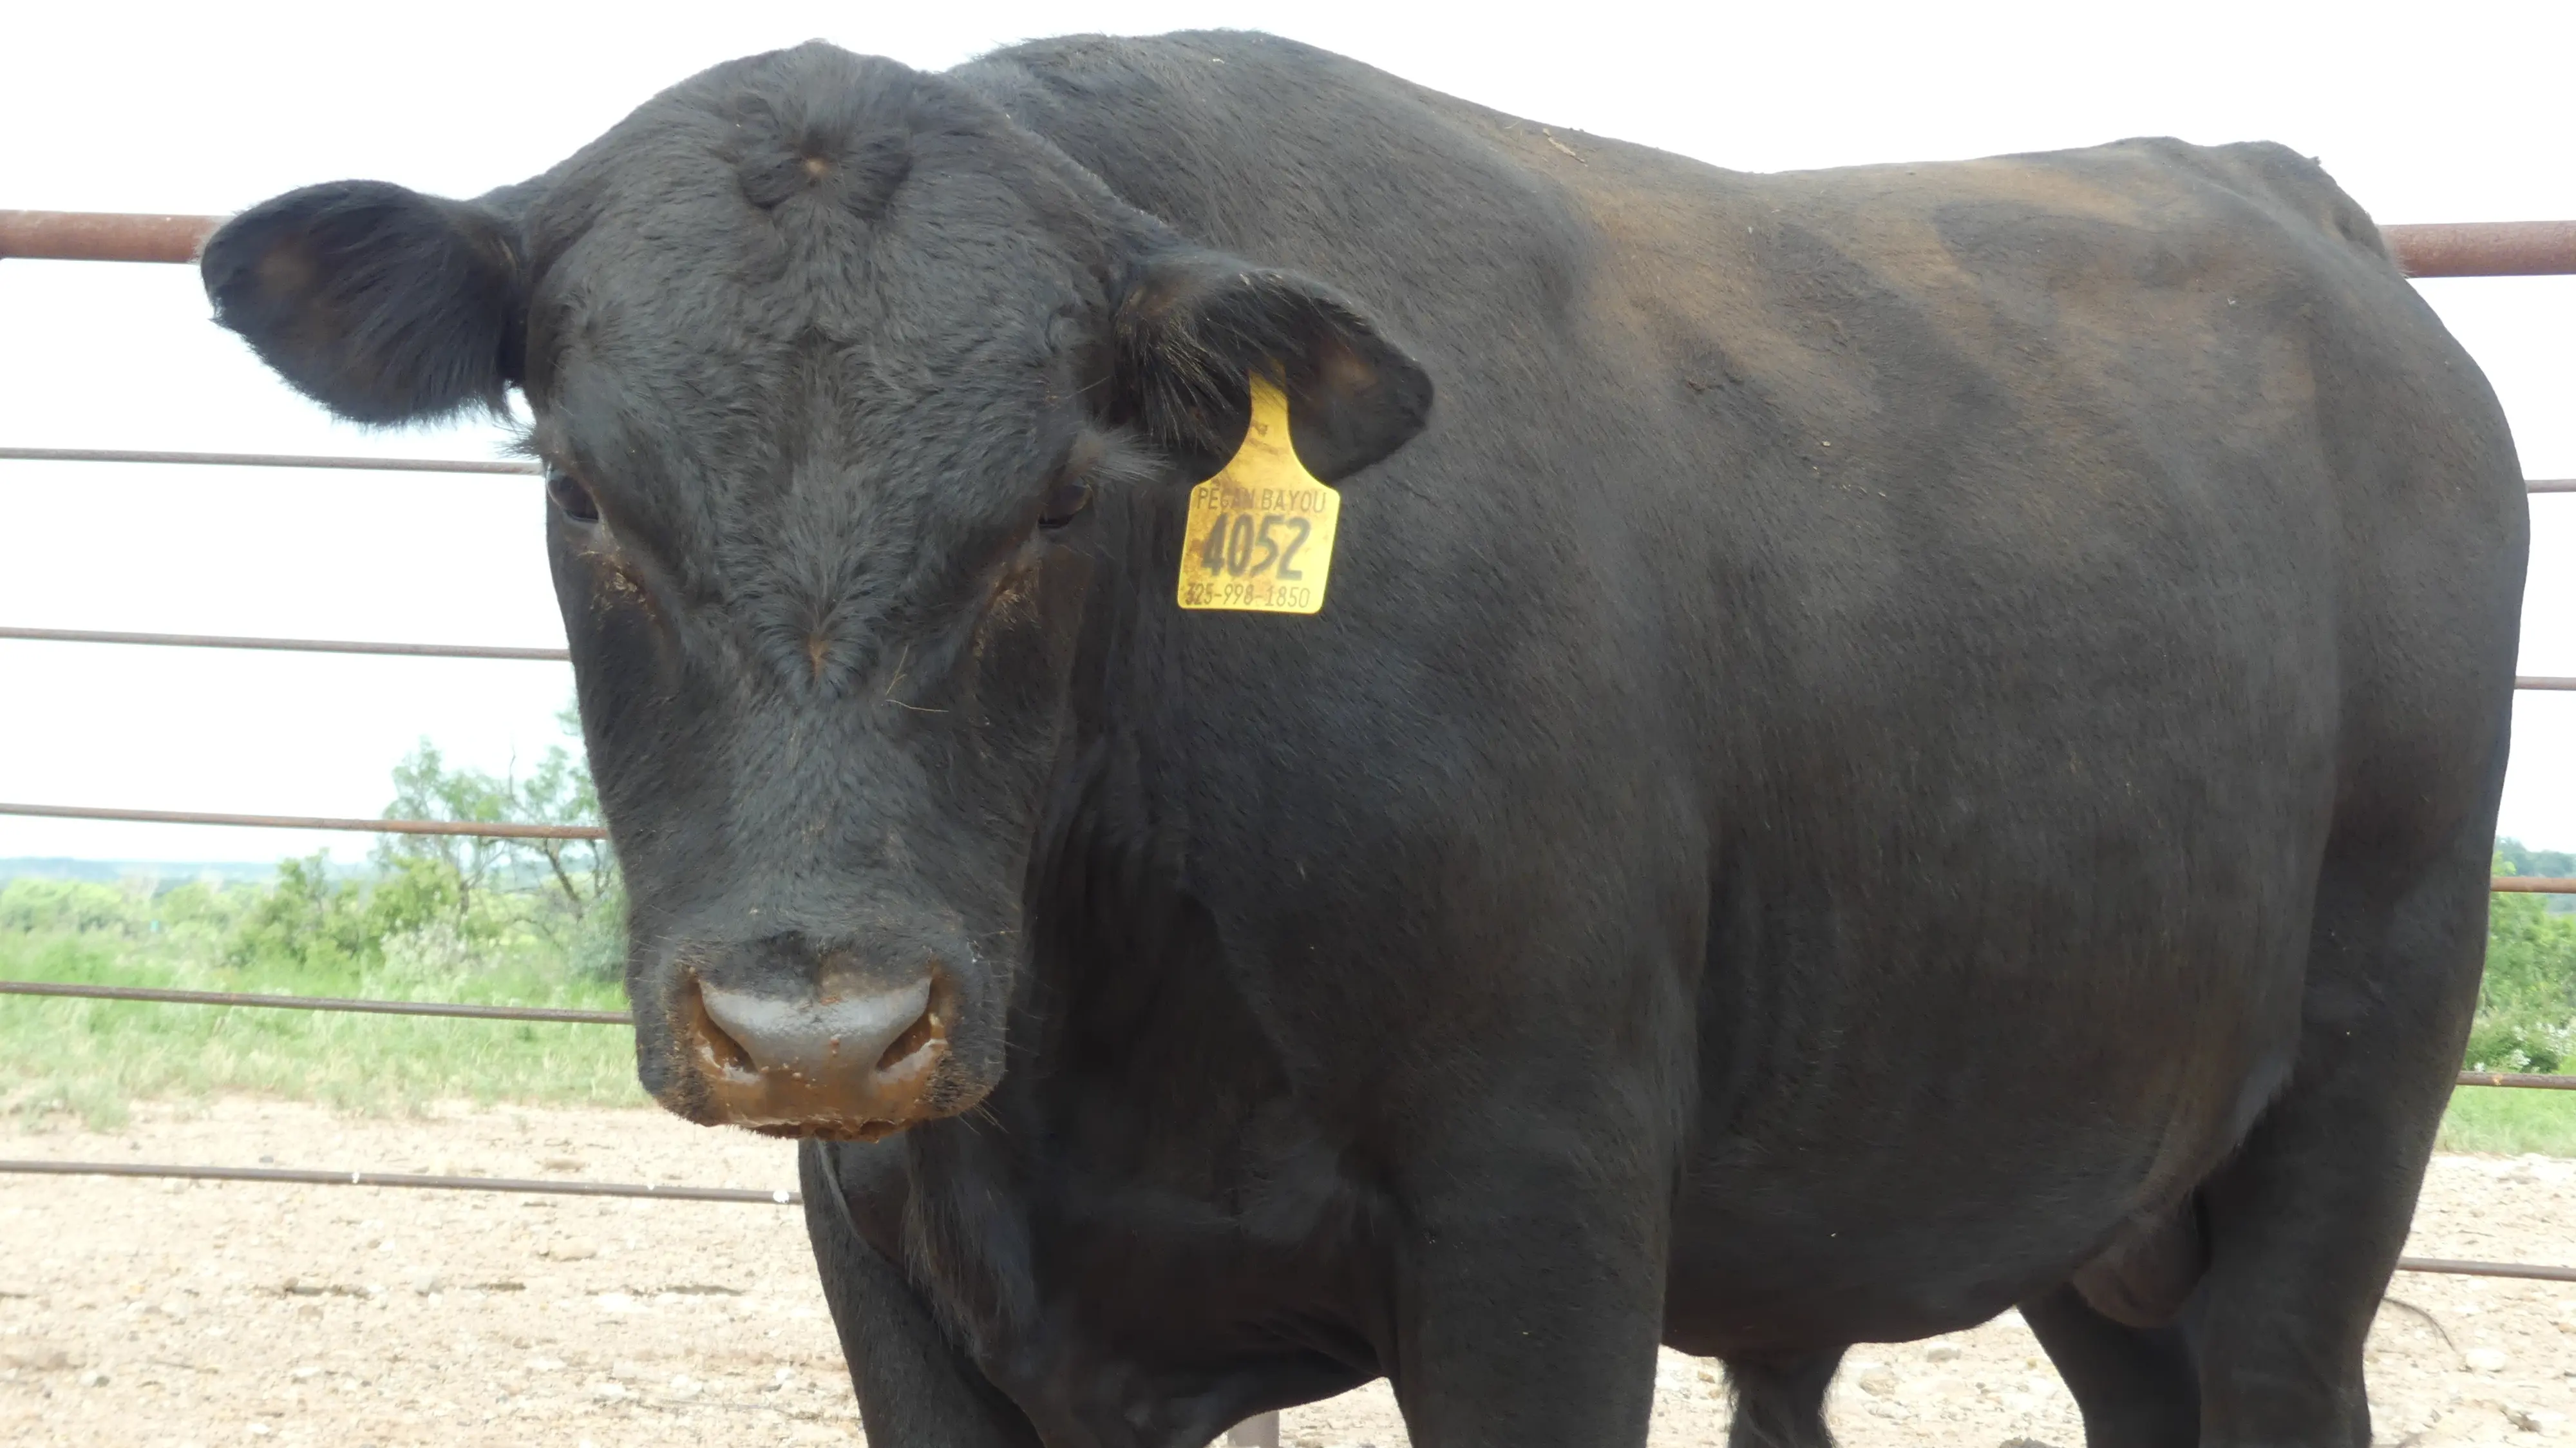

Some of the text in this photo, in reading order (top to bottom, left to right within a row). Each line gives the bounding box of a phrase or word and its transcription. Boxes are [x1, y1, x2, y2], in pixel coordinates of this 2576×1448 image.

[1262, 488, 1327, 513] BAYOU
[1200, 513, 1311, 580] 4052
[1185, 583, 1310, 608] 325-998-1850
